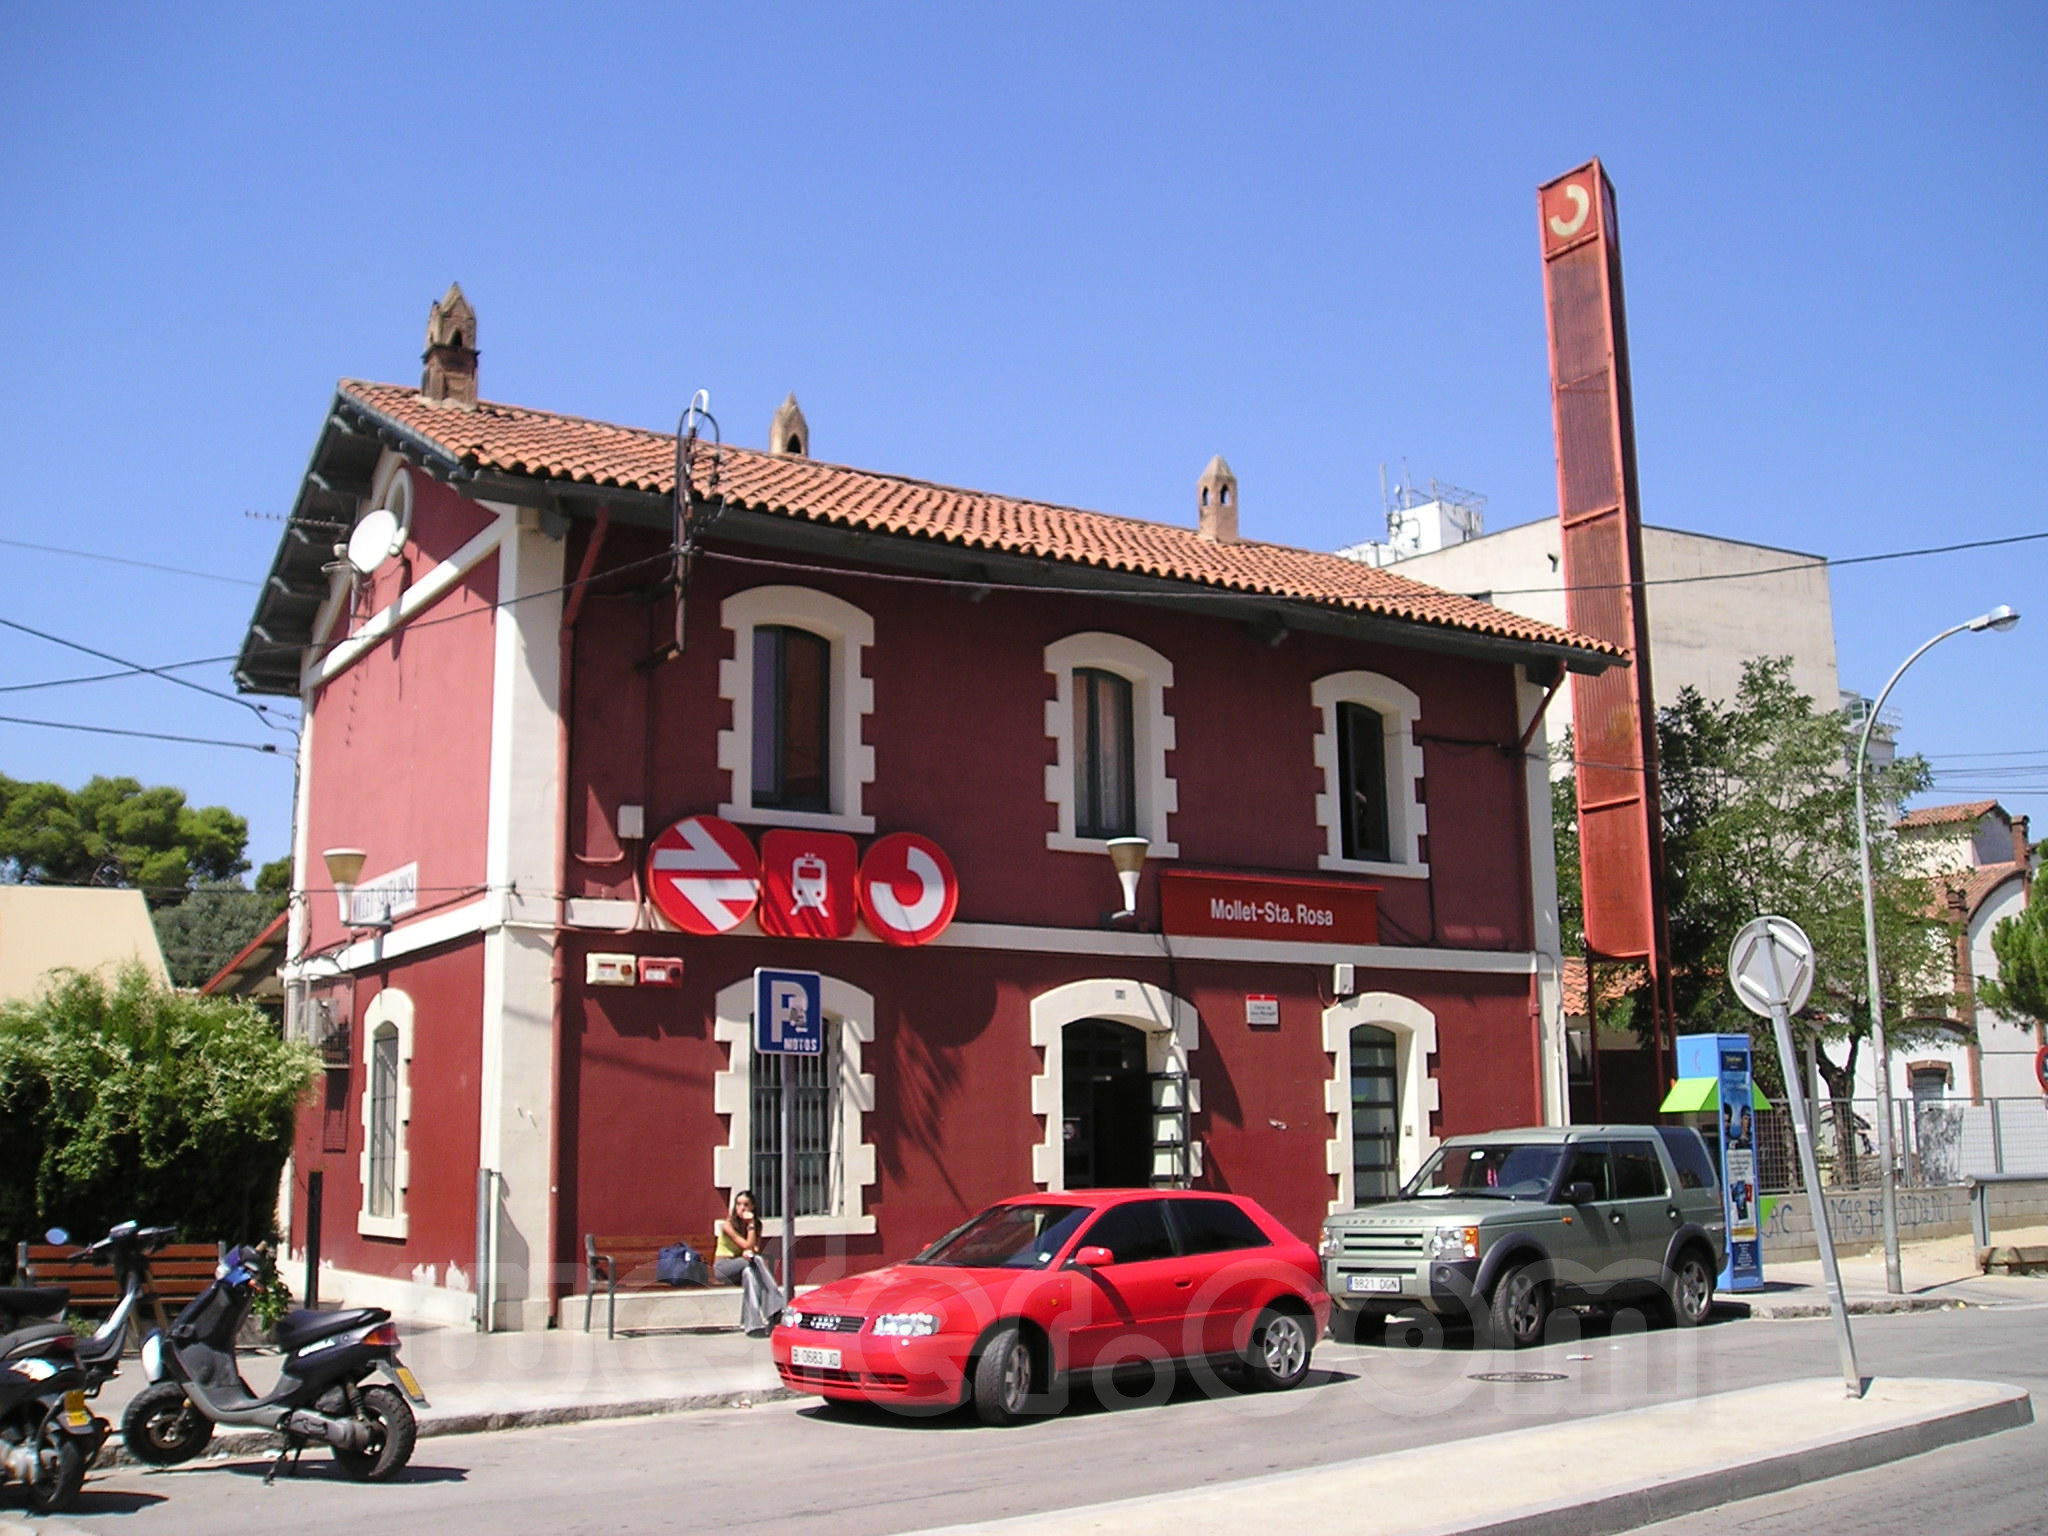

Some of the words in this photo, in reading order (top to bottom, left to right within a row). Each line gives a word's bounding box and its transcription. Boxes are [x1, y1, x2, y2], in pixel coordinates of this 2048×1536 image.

[1210, 898, 1294, 924] Mollet-Sta.
[1297, 904, 1334, 926] Rosa
[770, 980, 809, 1043] P
[783, 1037, 817, 1052] MOTOS
